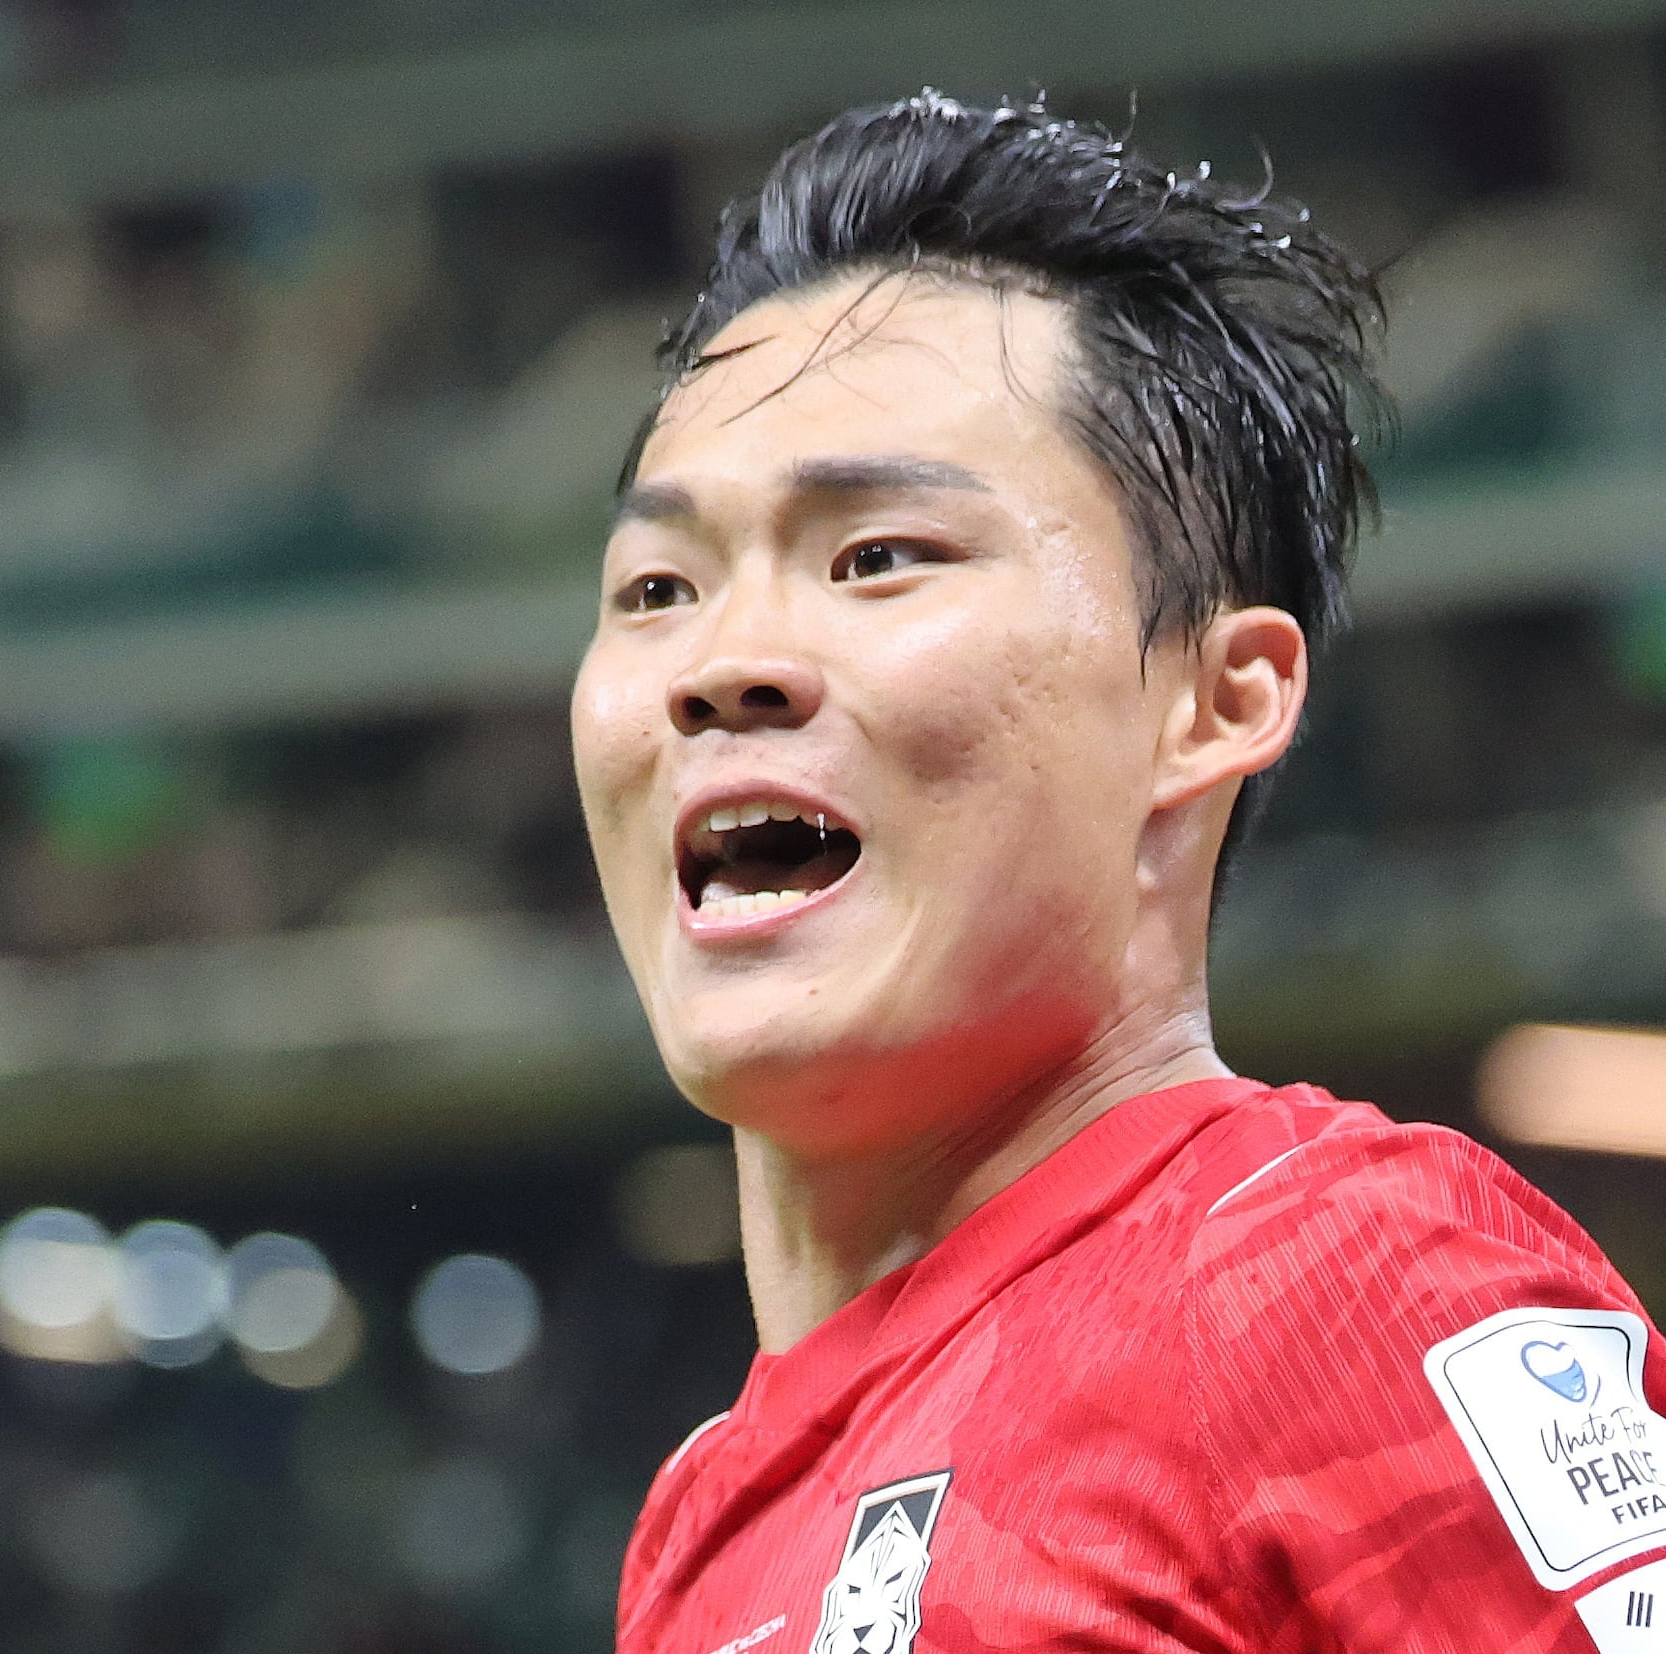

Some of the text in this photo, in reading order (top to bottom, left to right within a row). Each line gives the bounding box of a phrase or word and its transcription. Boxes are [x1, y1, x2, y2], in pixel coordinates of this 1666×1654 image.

[1540, 1406, 1647, 1464] Unite For
[1566, 1449, 1666, 1506] PEACE
